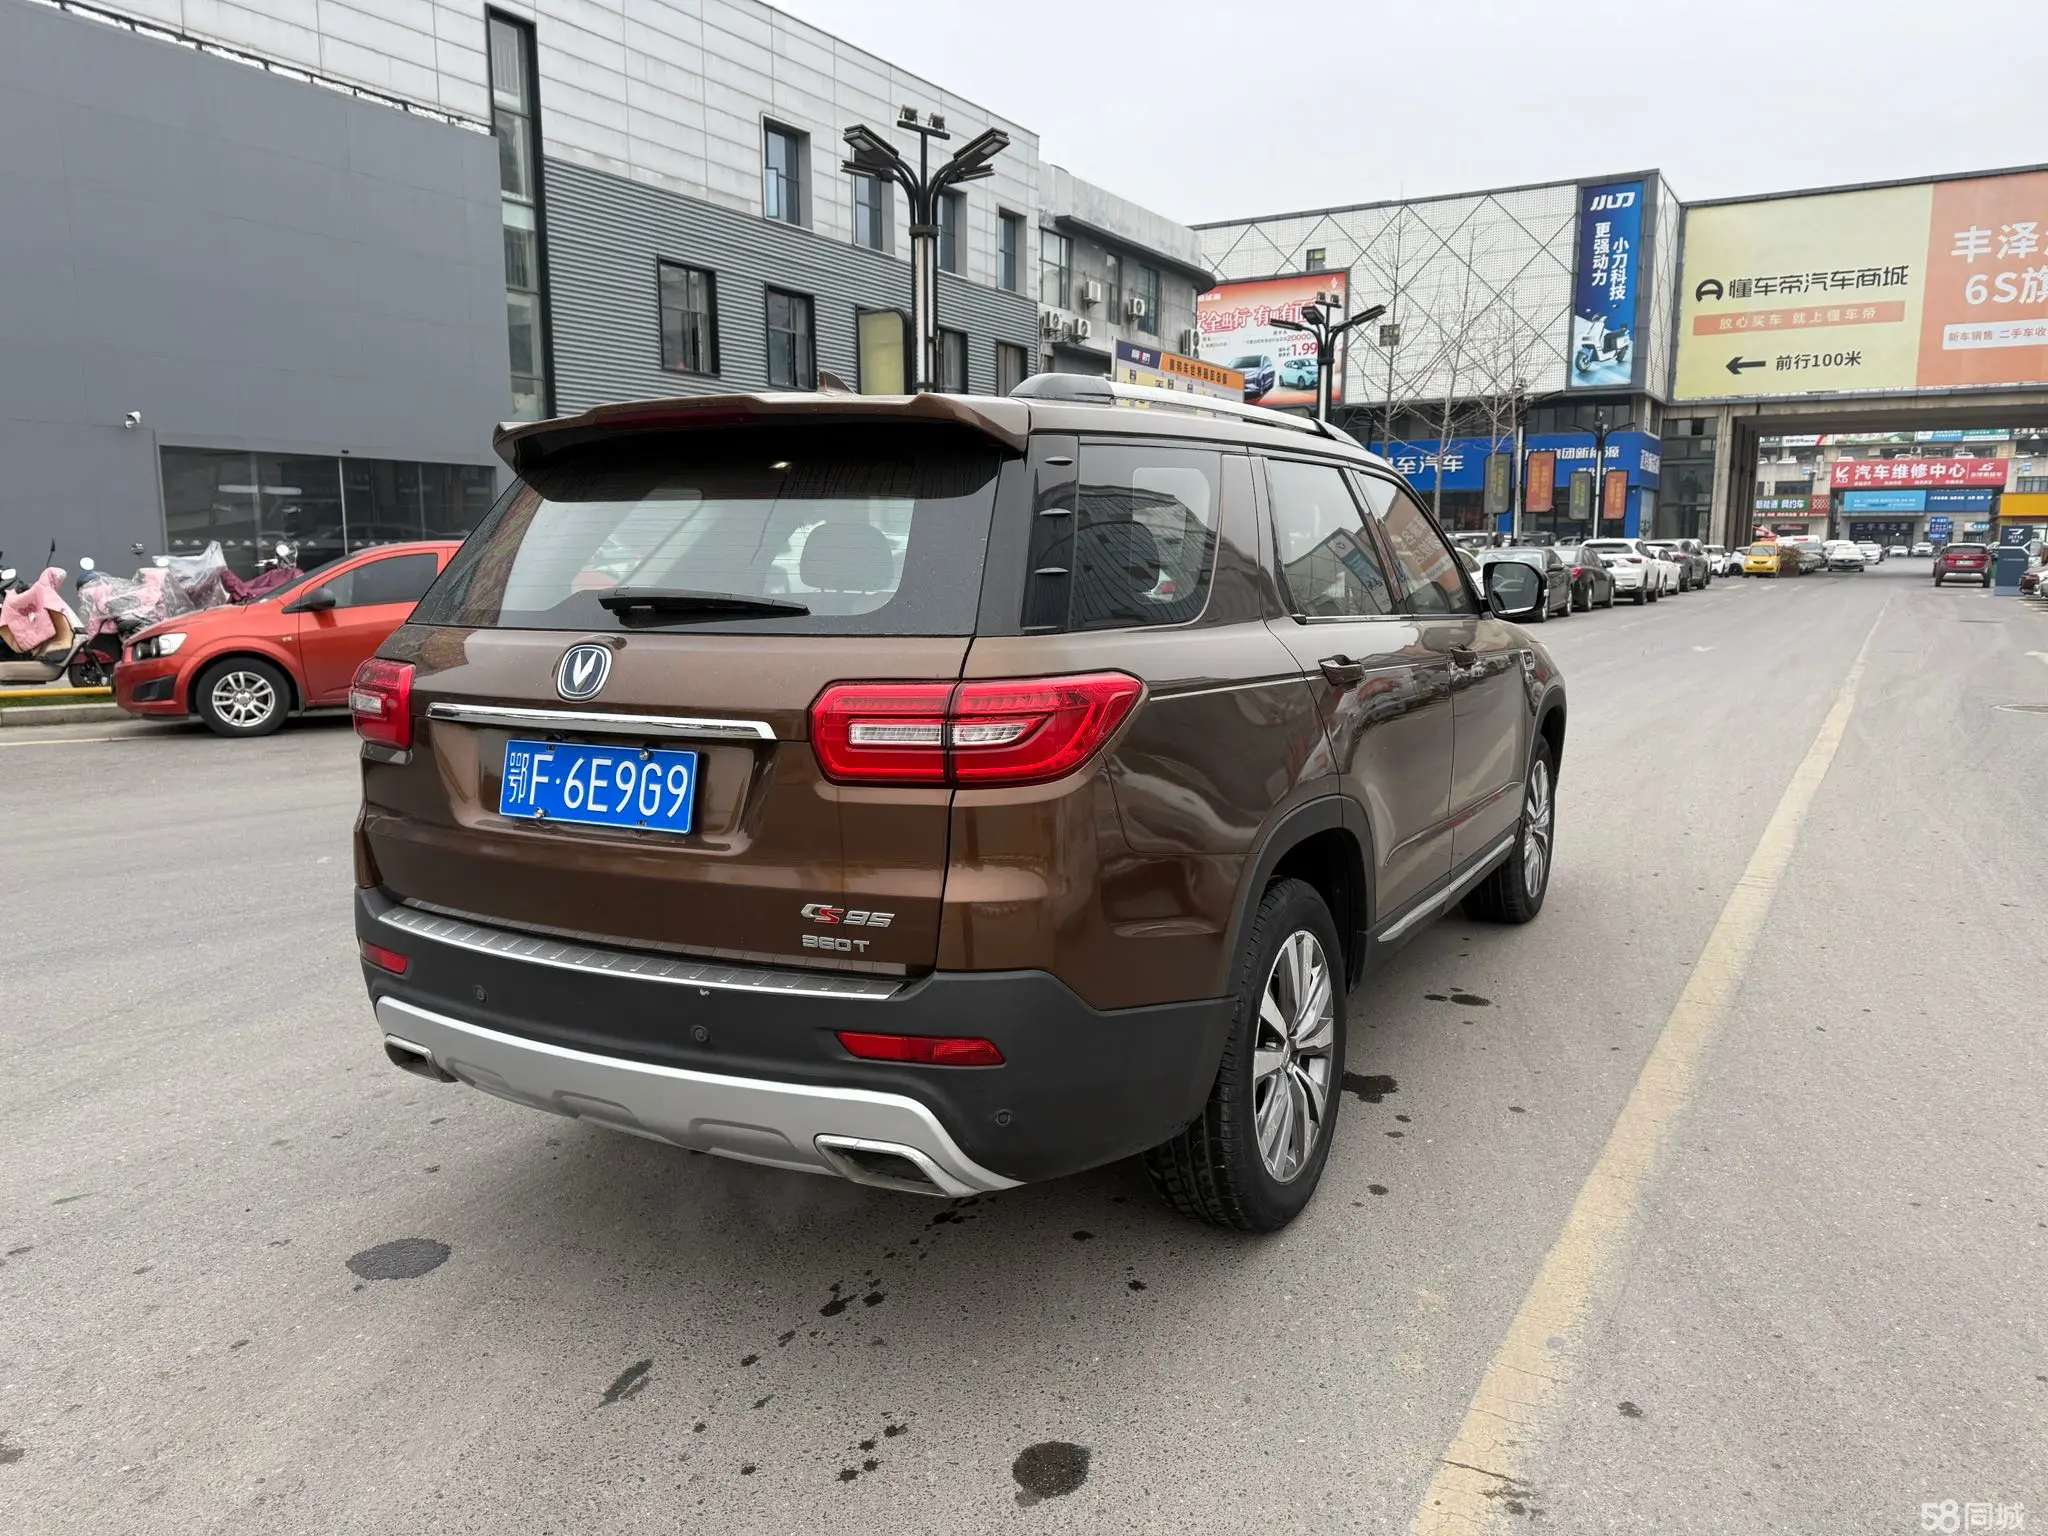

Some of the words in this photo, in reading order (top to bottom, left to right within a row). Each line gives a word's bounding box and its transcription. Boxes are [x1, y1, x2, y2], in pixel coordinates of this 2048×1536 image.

[1592, 222, 1612, 286] 更强动力
[1951, 222, 2048, 263] 丰泽
[1609, 237, 1630, 301] 小刀科技
[1729, 265, 1909, 298] 懂车帝汽车商城
[1719, 313, 1783, 330] 放心买车
[1792, 307, 1877, 326] 就上懂车帝
[1948, 330, 1993, 342] 新车销售
[1775, 350, 1863, 371] 前行100米
[1854, 463, 1966, 480] 汽车维修中心
[802, 934, 870, 953] 360T
